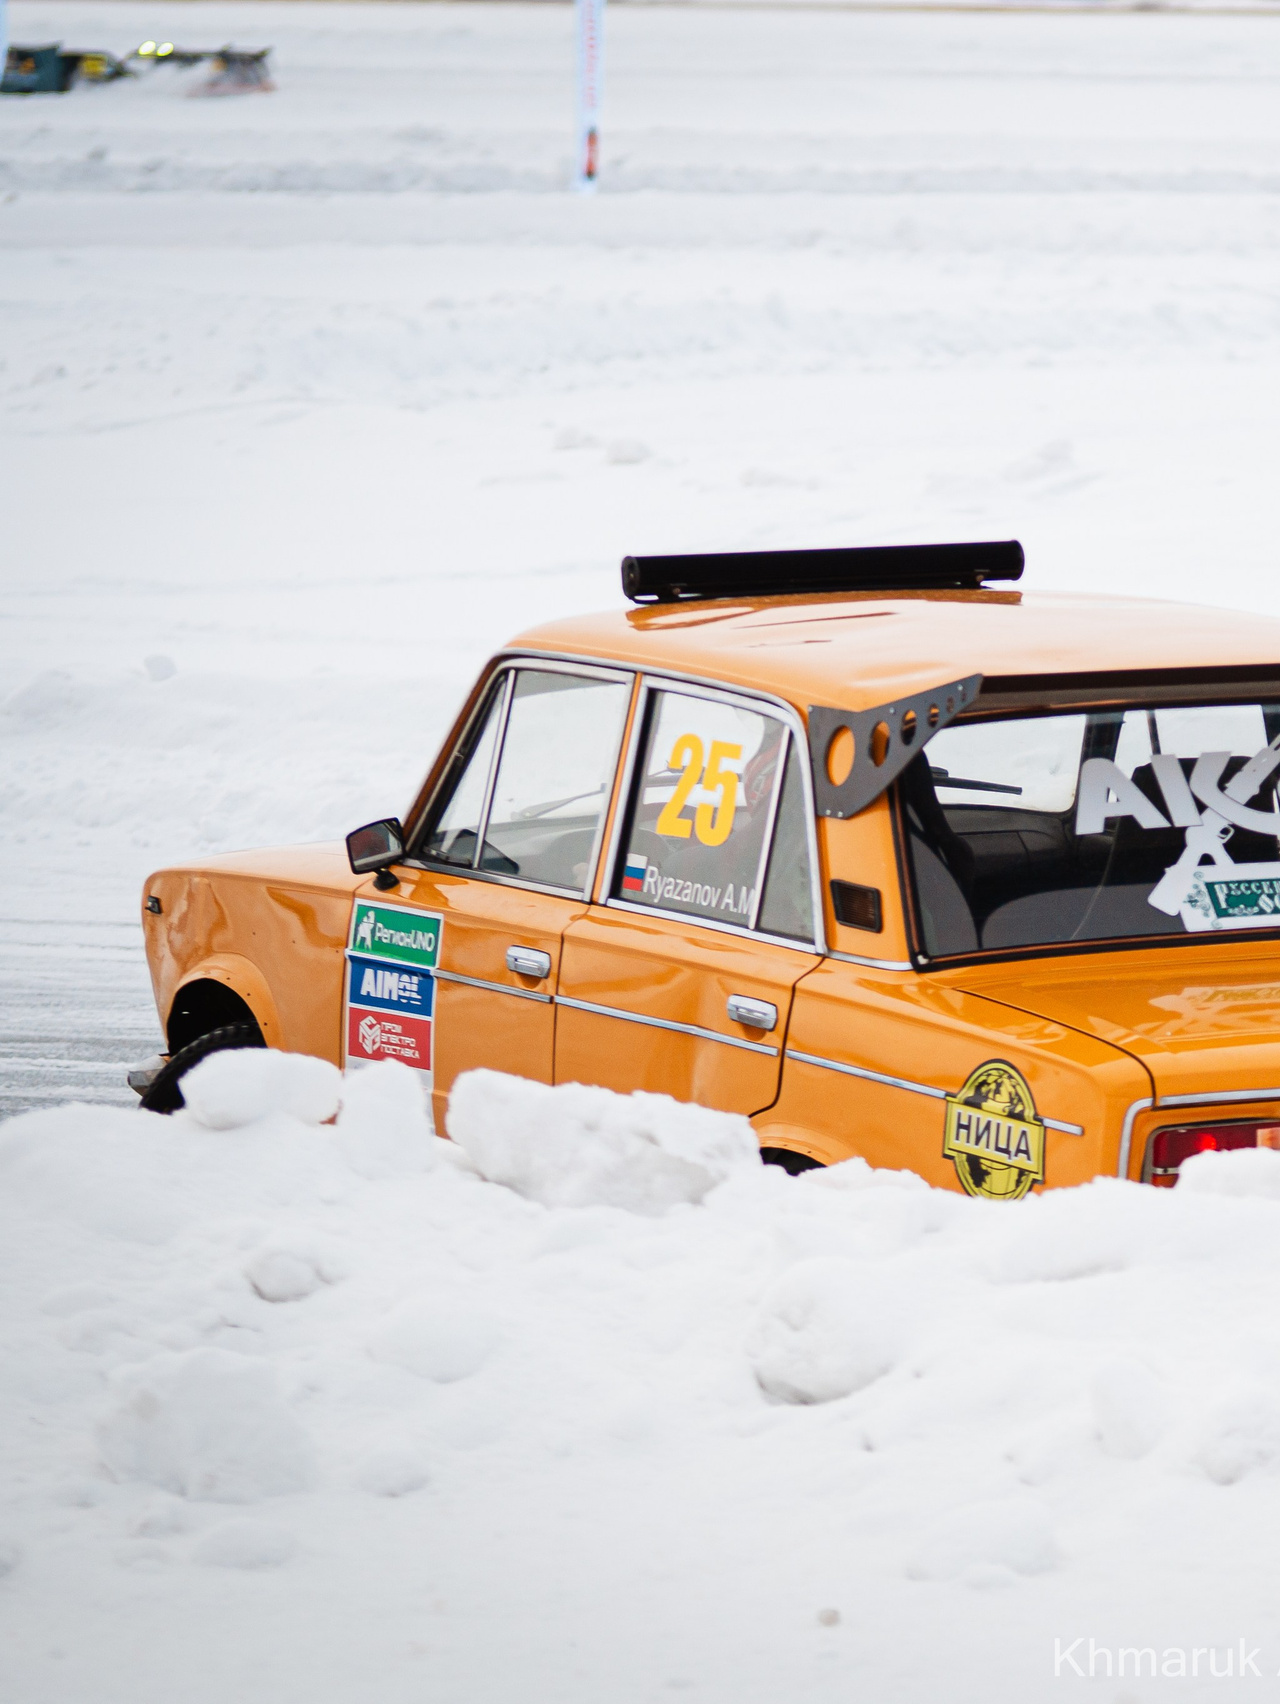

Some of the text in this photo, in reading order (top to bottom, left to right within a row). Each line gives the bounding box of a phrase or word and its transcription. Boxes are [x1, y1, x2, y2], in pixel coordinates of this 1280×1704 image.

[656, 732, 743, 847] 25
[643, 865, 721, 908] Ryazanov
[954, 1110, 1033, 1162] НИЦА
